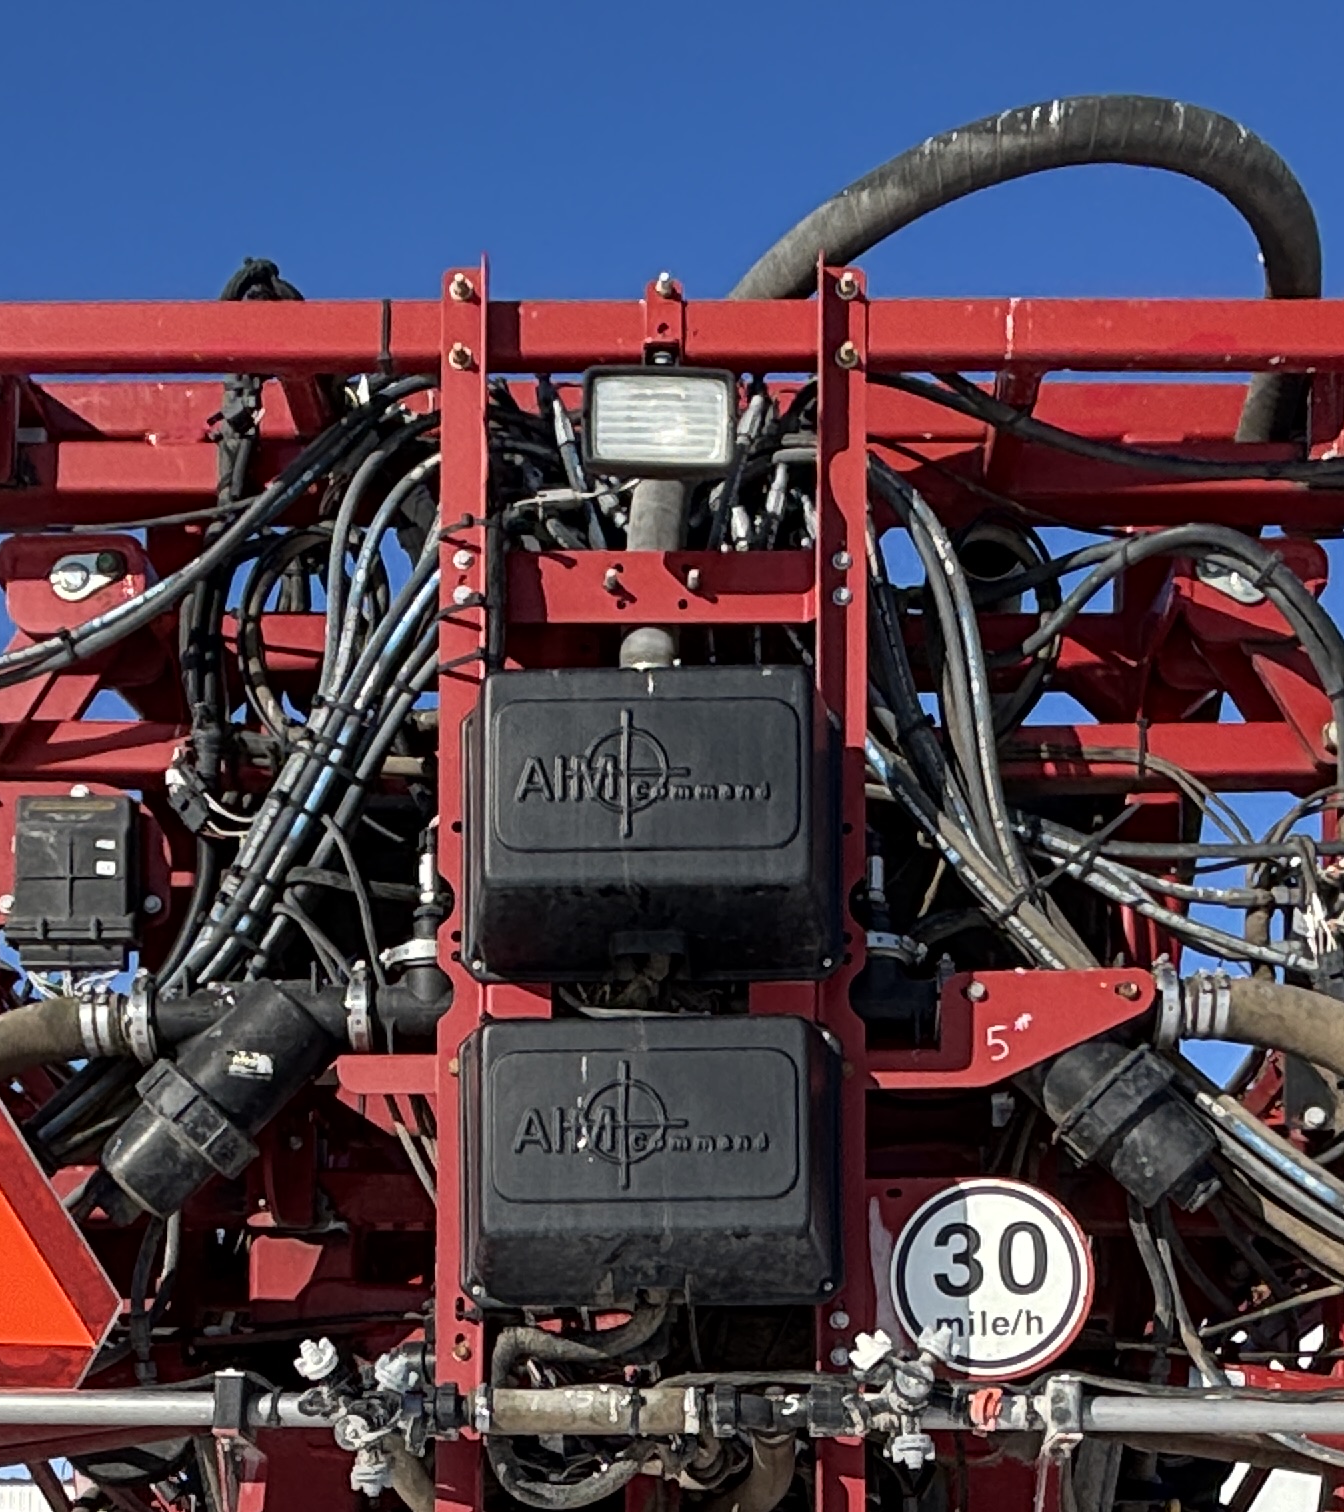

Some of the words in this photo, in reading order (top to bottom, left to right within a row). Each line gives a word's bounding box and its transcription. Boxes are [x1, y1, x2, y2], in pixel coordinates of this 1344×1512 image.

[513, 753, 619, 803] AIM
[932, 1220, 1049, 1298] 30
[935, 1308, 1045, 1338] mile/h
